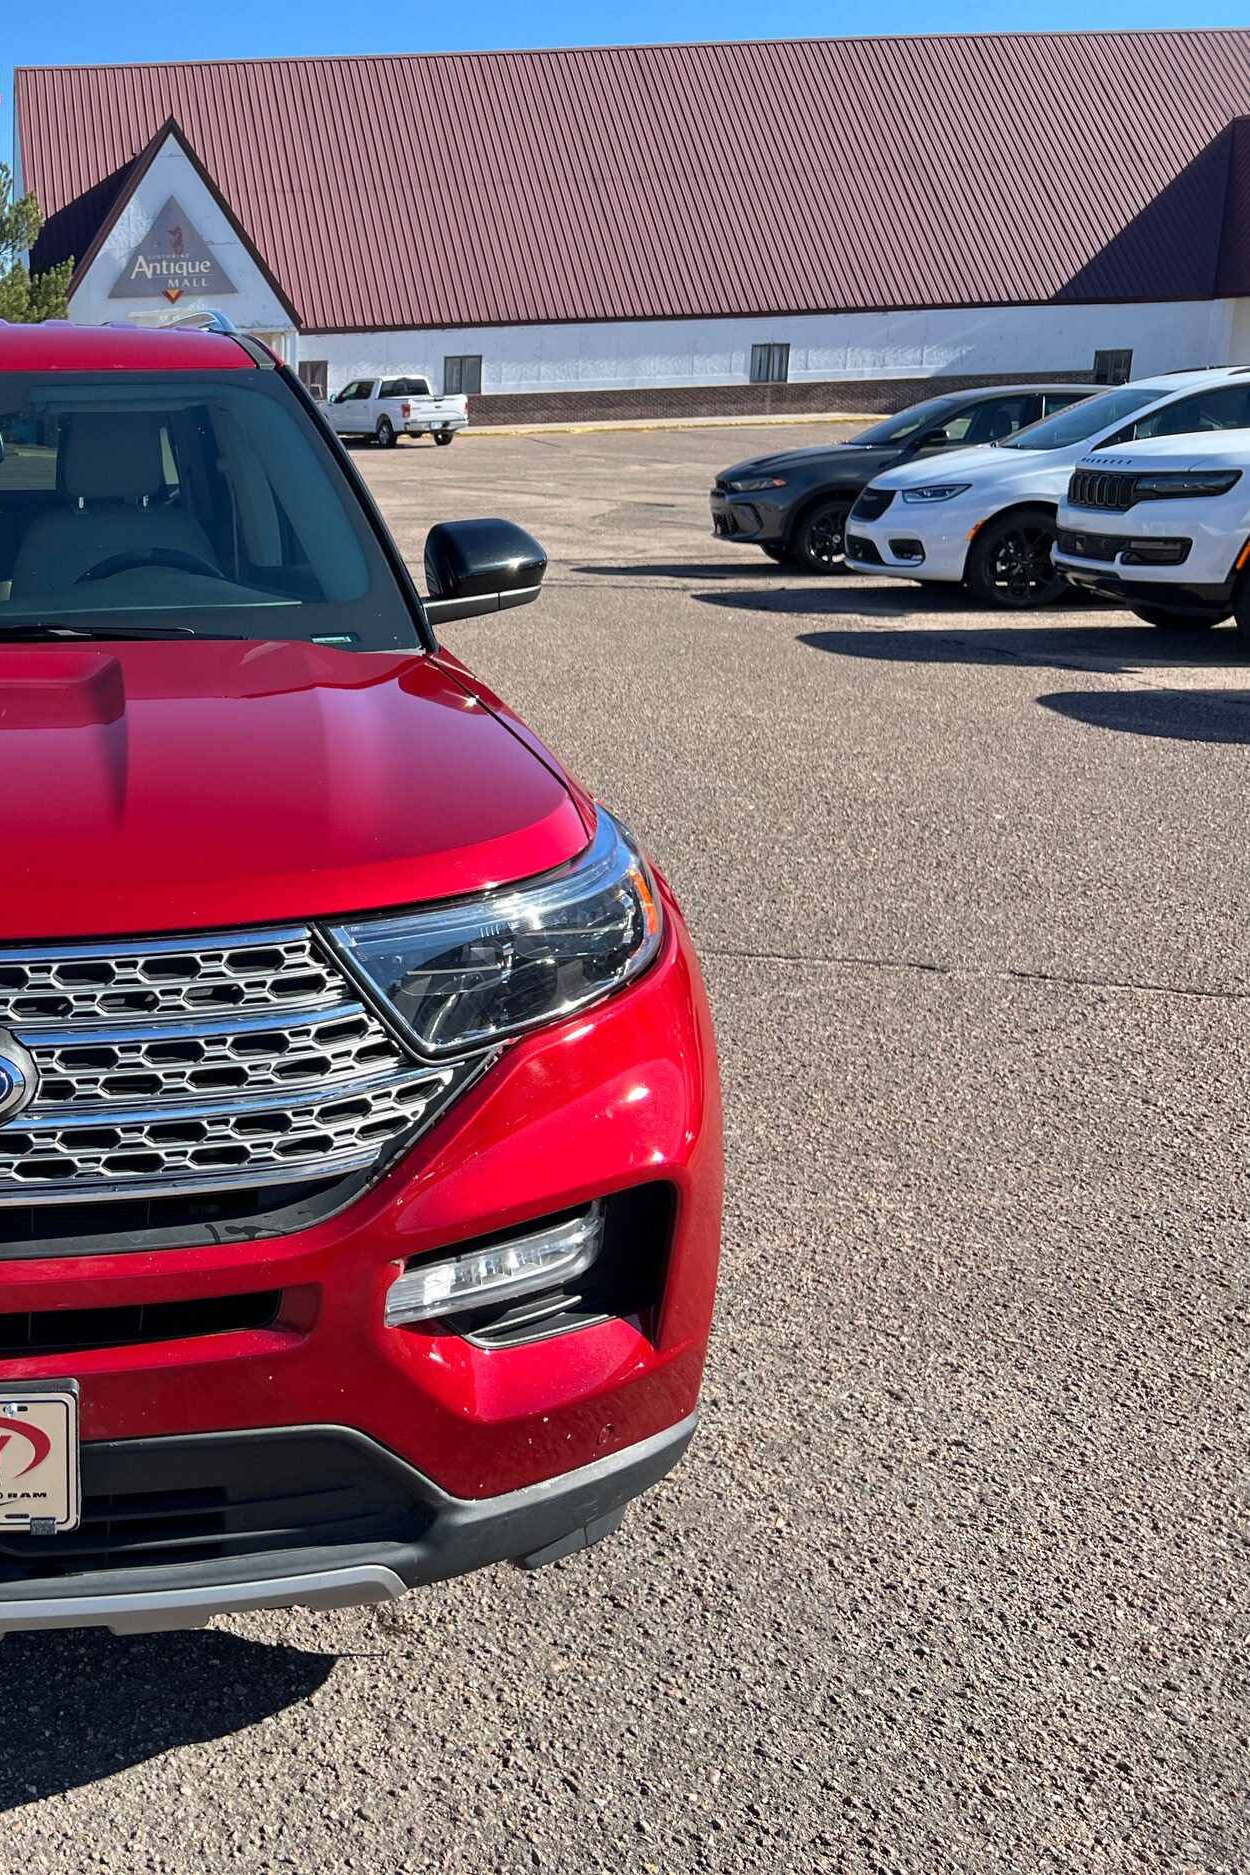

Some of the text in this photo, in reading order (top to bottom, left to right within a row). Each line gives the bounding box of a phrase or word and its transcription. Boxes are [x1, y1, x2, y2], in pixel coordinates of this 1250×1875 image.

[131, 255, 211, 279] Antique
[167, 278, 208, 288] MALL
[7, 1491, 47, 1499] RAM
